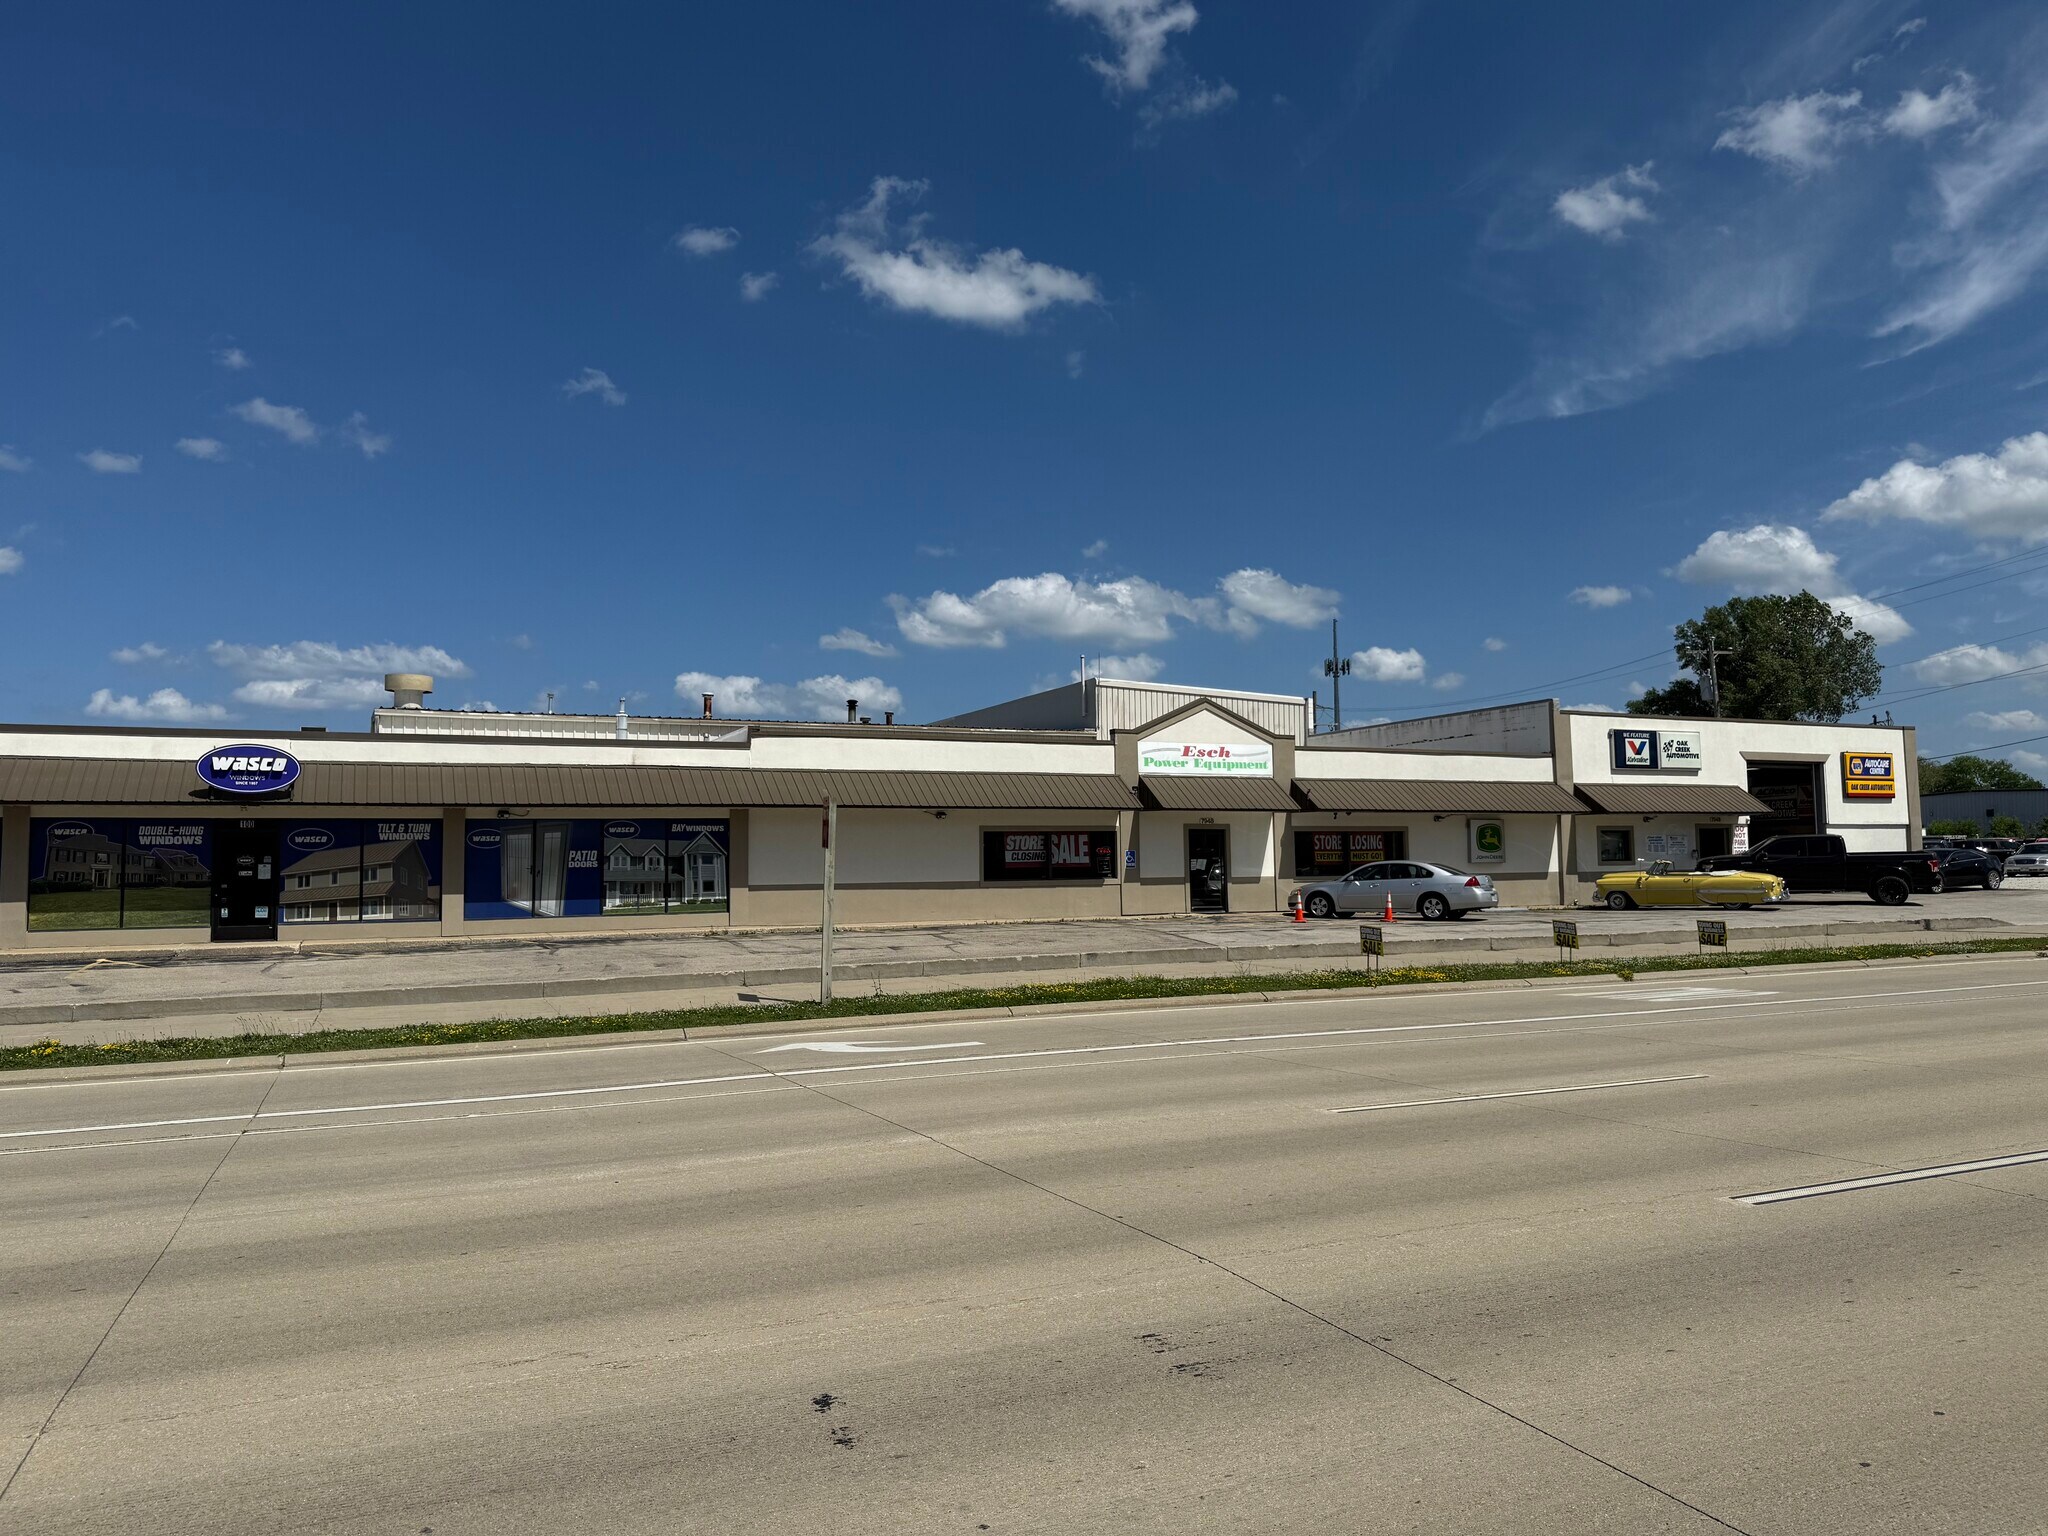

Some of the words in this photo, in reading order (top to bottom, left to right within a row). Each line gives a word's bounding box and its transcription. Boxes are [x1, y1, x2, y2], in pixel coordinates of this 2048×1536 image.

[1181, 745, 1231, 757] Esch
[1143, 757, 1188, 767] Power
[1194, 758, 1268, 771] Equipment
[1771, 801, 1794, 809] CREEK
[139, 826, 204, 835] DOUBLE-HUNG
[378, 823, 396, 832] TILT
[398, 824, 404, 832] &
[408, 824, 431, 832] TURN
[671, 824, 685, 832] BAY
[139, 836, 203, 844] WINDOWS
[379, 832, 430, 840] WINDOWS
[1007, 835, 1044, 850] STORE
[1314, 835, 1342, 850] STORE
[1051, 834, 1090, 864] SALE
[569, 850, 598, 861] PATIO
[1011, 852, 1046, 861] CLOSING
[1352, 852, 1369, 860] MUST
[1556, 934, 1576, 948] SALE
[1701, 933, 1725, 946] SALE
[1362, 940, 1382, 955] SALE
